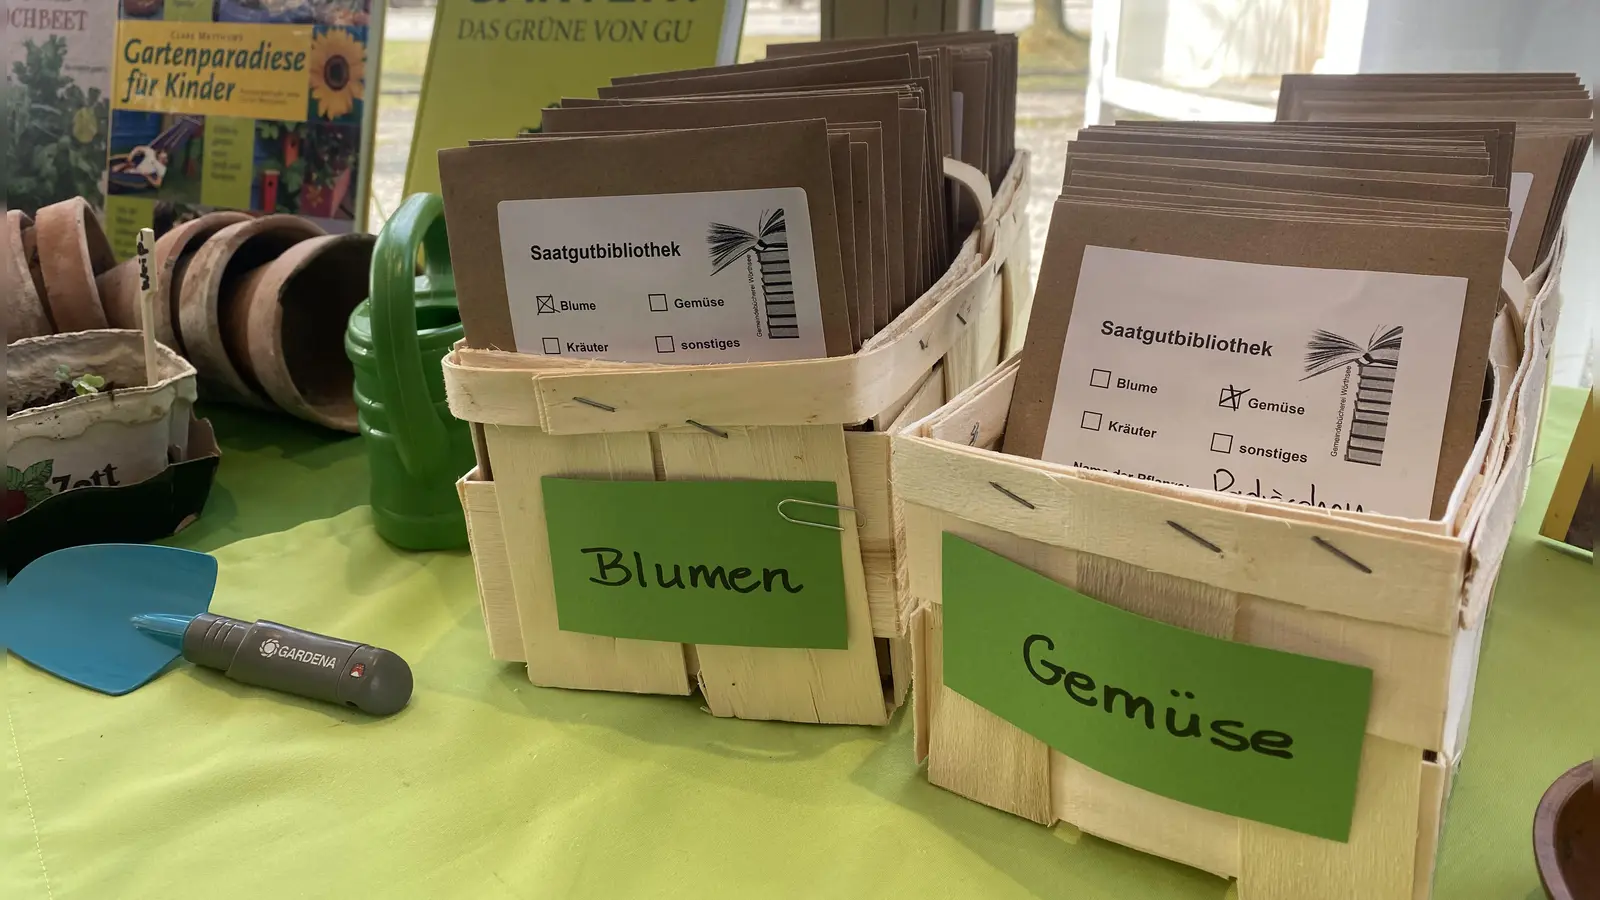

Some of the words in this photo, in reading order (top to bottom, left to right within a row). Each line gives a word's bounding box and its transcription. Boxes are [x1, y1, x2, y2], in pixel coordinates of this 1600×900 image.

[7, 8, 88, 31] CHBEET
[458, 18, 500, 41] DAS
[505, 16, 587, 43] GRÜNE
[594, 19, 647, 43] VON
[653, 19, 693, 43] GU
[124, 38, 306, 75] Gartenparadiese
[122, 68, 160, 103] für
[165, 72, 236, 101] Kinder
[530, 240, 681, 264] Saatgutbibliothek
[560, 299, 597, 312] Blume
[674, 296, 725, 310] Gemüse
[566, 341, 609, 353] Kräuter
[681, 337, 741, 351] sonstiges
[1100, 319, 1273, 358] Saatgutbibliothek
[1116, 377, 1158, 394] Blume
[1247, 396, 1306, 416] Gemüse
[1108, 420, 1158, 439] Kräuter
[1330, 396, 1347, 457] Gemeindebücherei
[1239, 442, 1308, 464] sonstiges
[580, 547, 805, 594] Blumen
[278, 645, 337, 669] GARDENA
[1022, 633, 1295, 760] Gemüse
